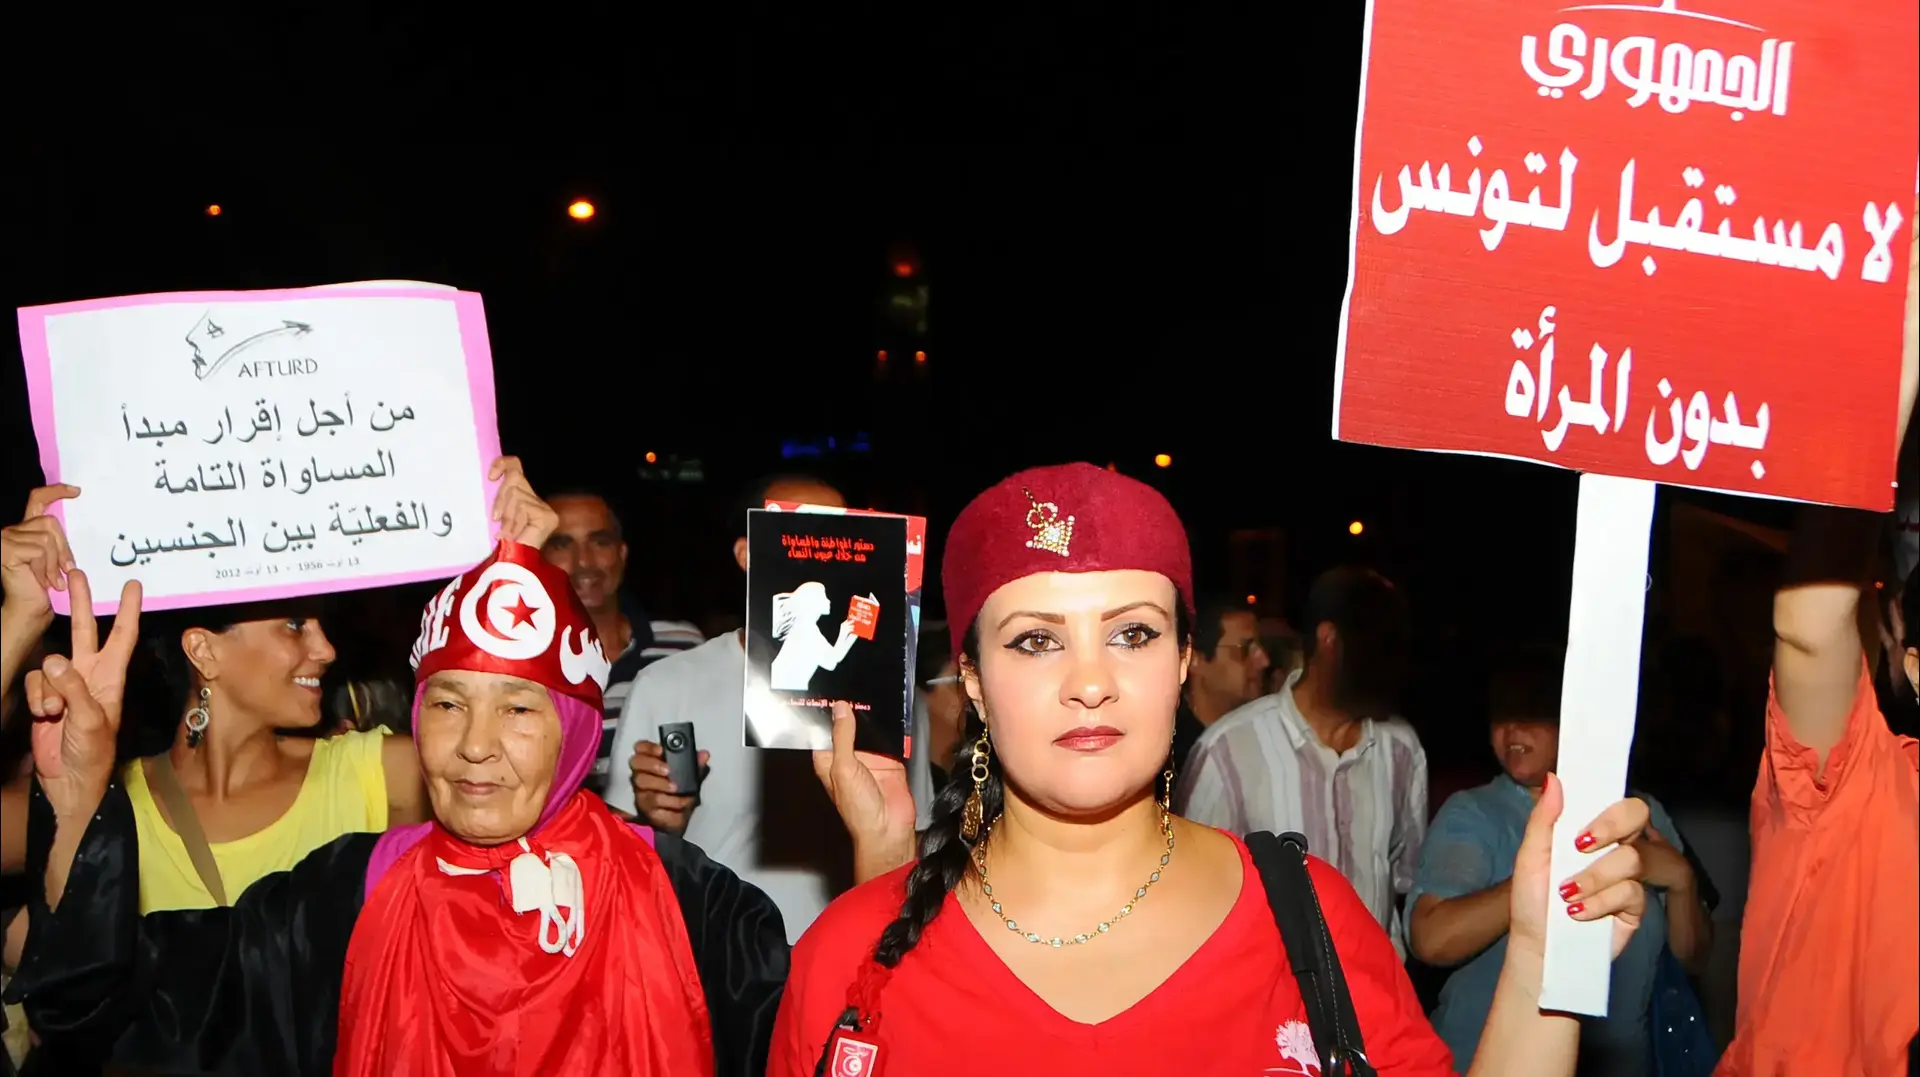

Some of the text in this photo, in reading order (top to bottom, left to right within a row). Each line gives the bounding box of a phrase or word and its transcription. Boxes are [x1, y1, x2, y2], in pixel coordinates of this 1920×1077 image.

[1520, 22, 1796, 122] الجمهوري
[1371, 135, 1904, 283] لا مستقبل لتونس
[237, 358, 318, 379] AFTURD
[1504, 305, 1770, 480] بدون المرأة
[121, 391, 415, 448] من أجل إقرار مبدأ
[154, 448, 395, 495] المساواة التامة
[110, 517, 246, 567] الجنسين
[263, 521, 316, 553] بين
[215, 567, 241, 579] 2012
[266, 564, 279, 575] 13
[298, 561, 323, 572] 1956
